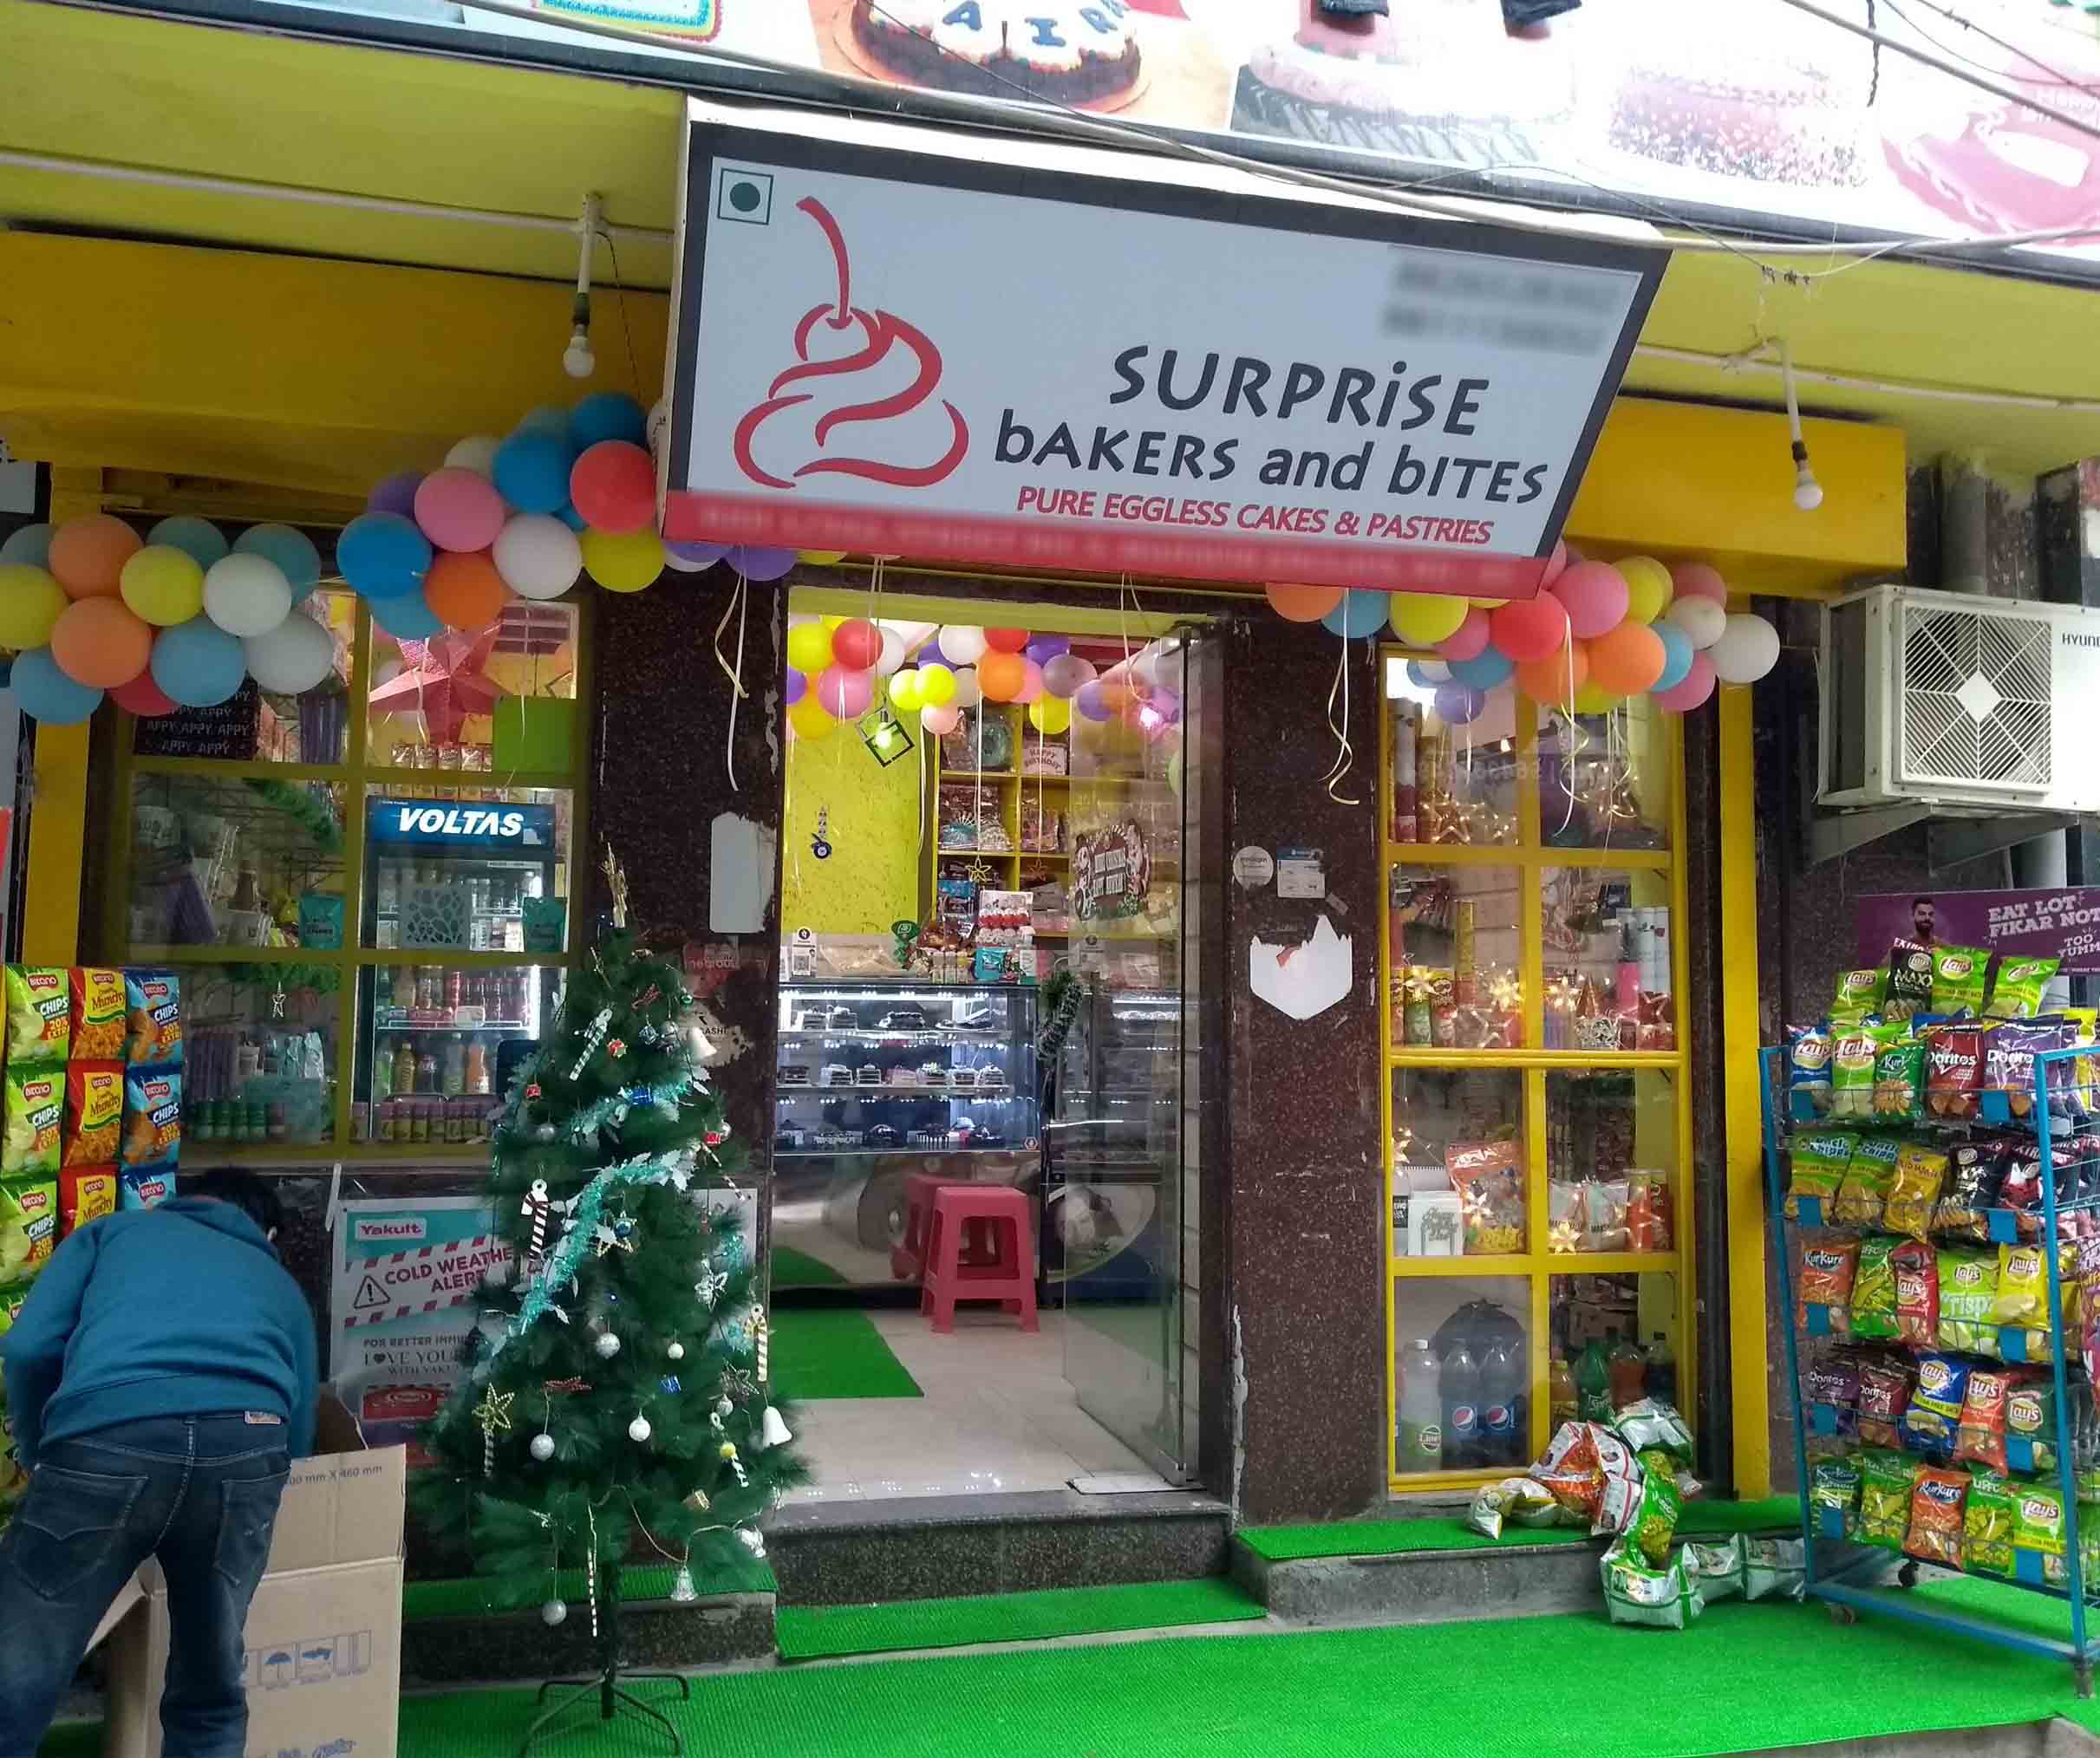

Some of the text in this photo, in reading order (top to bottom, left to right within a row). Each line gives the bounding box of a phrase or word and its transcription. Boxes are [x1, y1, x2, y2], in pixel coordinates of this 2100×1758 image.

[1258, 440, 1375, 492] and
[1017, 485, 1495, 545] PURE EGGLESS CAKES & PASTRIES
[399, 807, 524, 837] VOLTAS
[1988, 895, 2077, 922] EAT LOT
[1989, 908, 2100, 937] FIKAR NOT
[2064, 934, 2094, 947] TOO
[40, 997, 68, 1016] CHIPS
[154, 1003, 179, 1022] CHIPS
[1987, 1049, 2034, 1065] Dorito
[32, 1105, 60, 1127] CHIPS
[153, 1103, 179, 1123] CHIPS
[28, 1214, 55, 1237] CHIPS
[360, 1221, 423, 1236] Yakult
[385, 1248, 514, 1285] COLD WEATHE
[431, 1269, 486, 1292] ALERT
